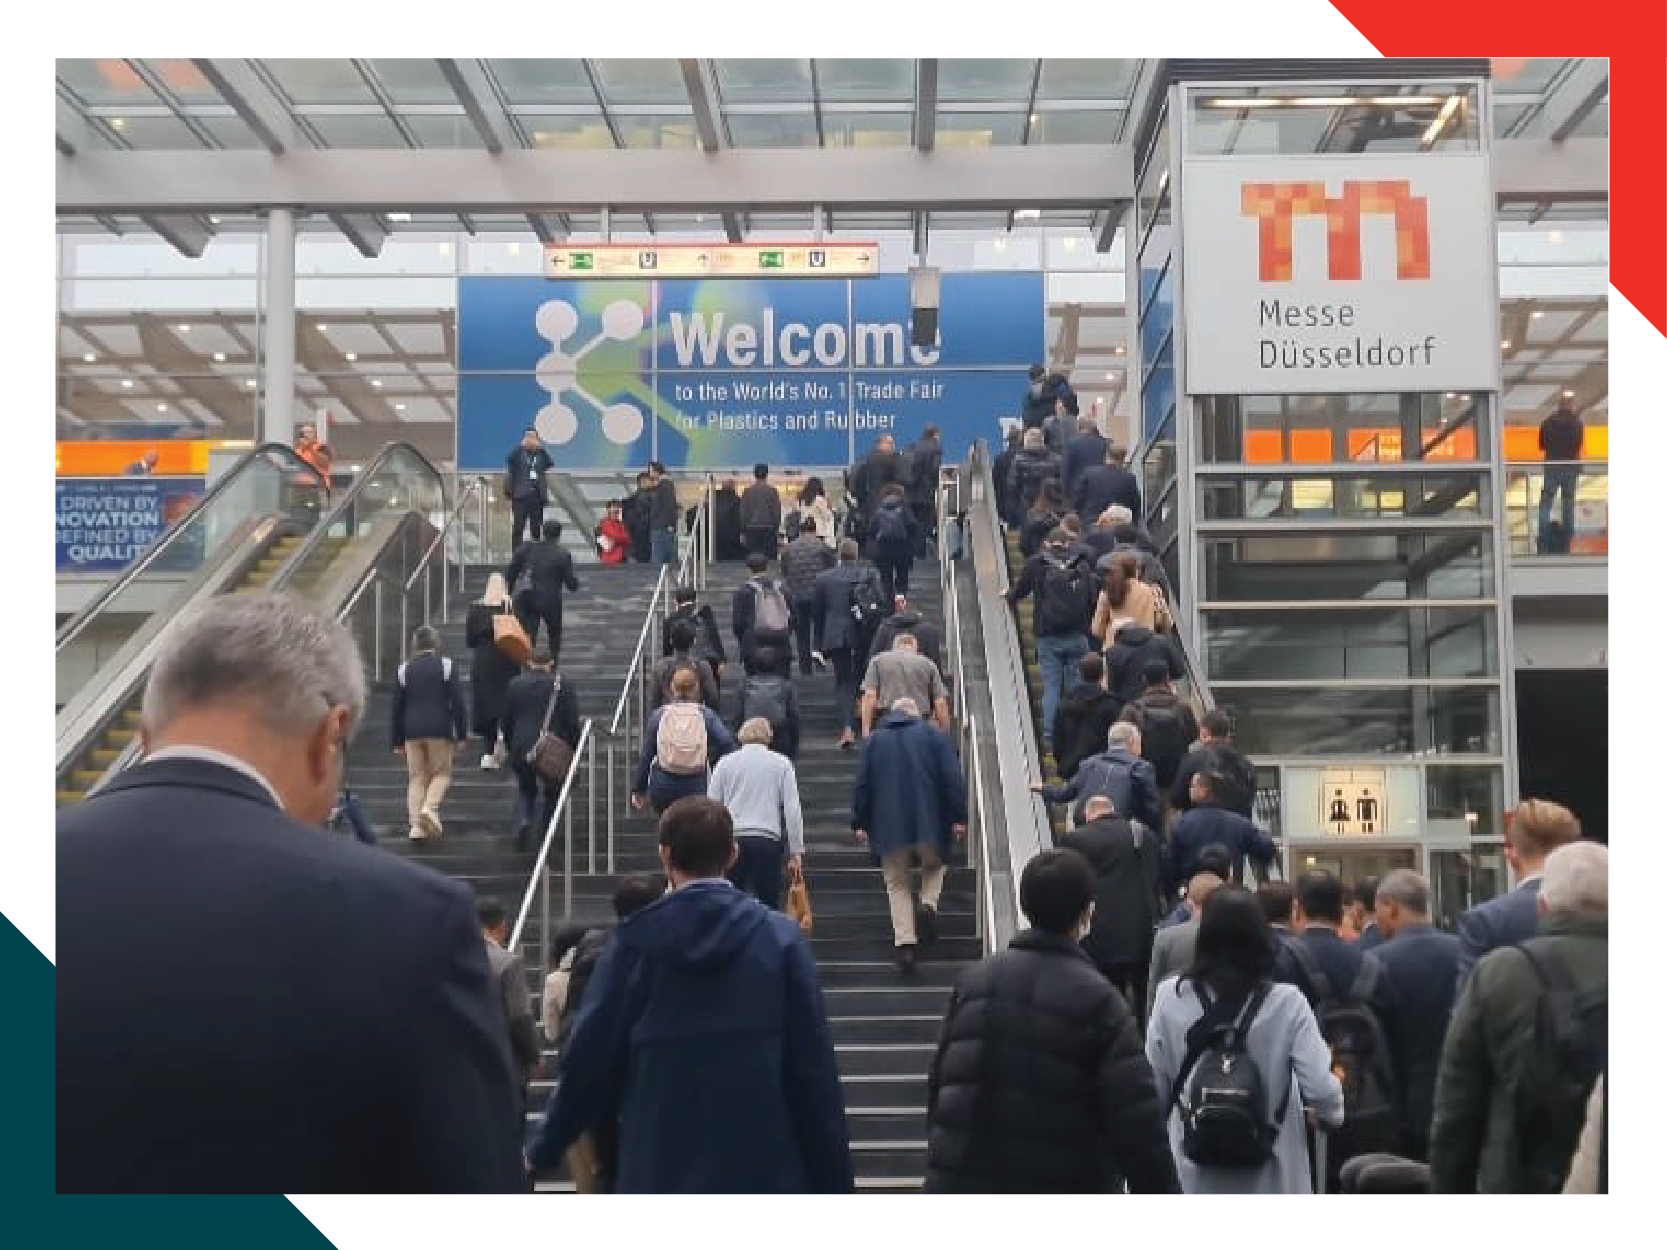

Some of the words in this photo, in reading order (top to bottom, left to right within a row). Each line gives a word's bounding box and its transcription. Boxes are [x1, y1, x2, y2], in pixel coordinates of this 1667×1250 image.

[1259, 299, 1355, 327] Messe
[1259, 336, 1436, 369] Düsseldorf
[675, 384, 693, 401] to
[699, 382, 728, 401] the
[733, 381, 799, 401] World's
[804, 382, 833, 401] No.
[856, 381, 904, 400] Trade
[910, 380, 944, 400] Fair
[675, 410, 700, 430] for
[707, 410, 778, 430] Plastics
[786, 410, 817, 430] and
[825, 410, 896, 430] Rubber
[61, 496, 129, 510] DRIVEN
[134, 496, 158, 510] BY
